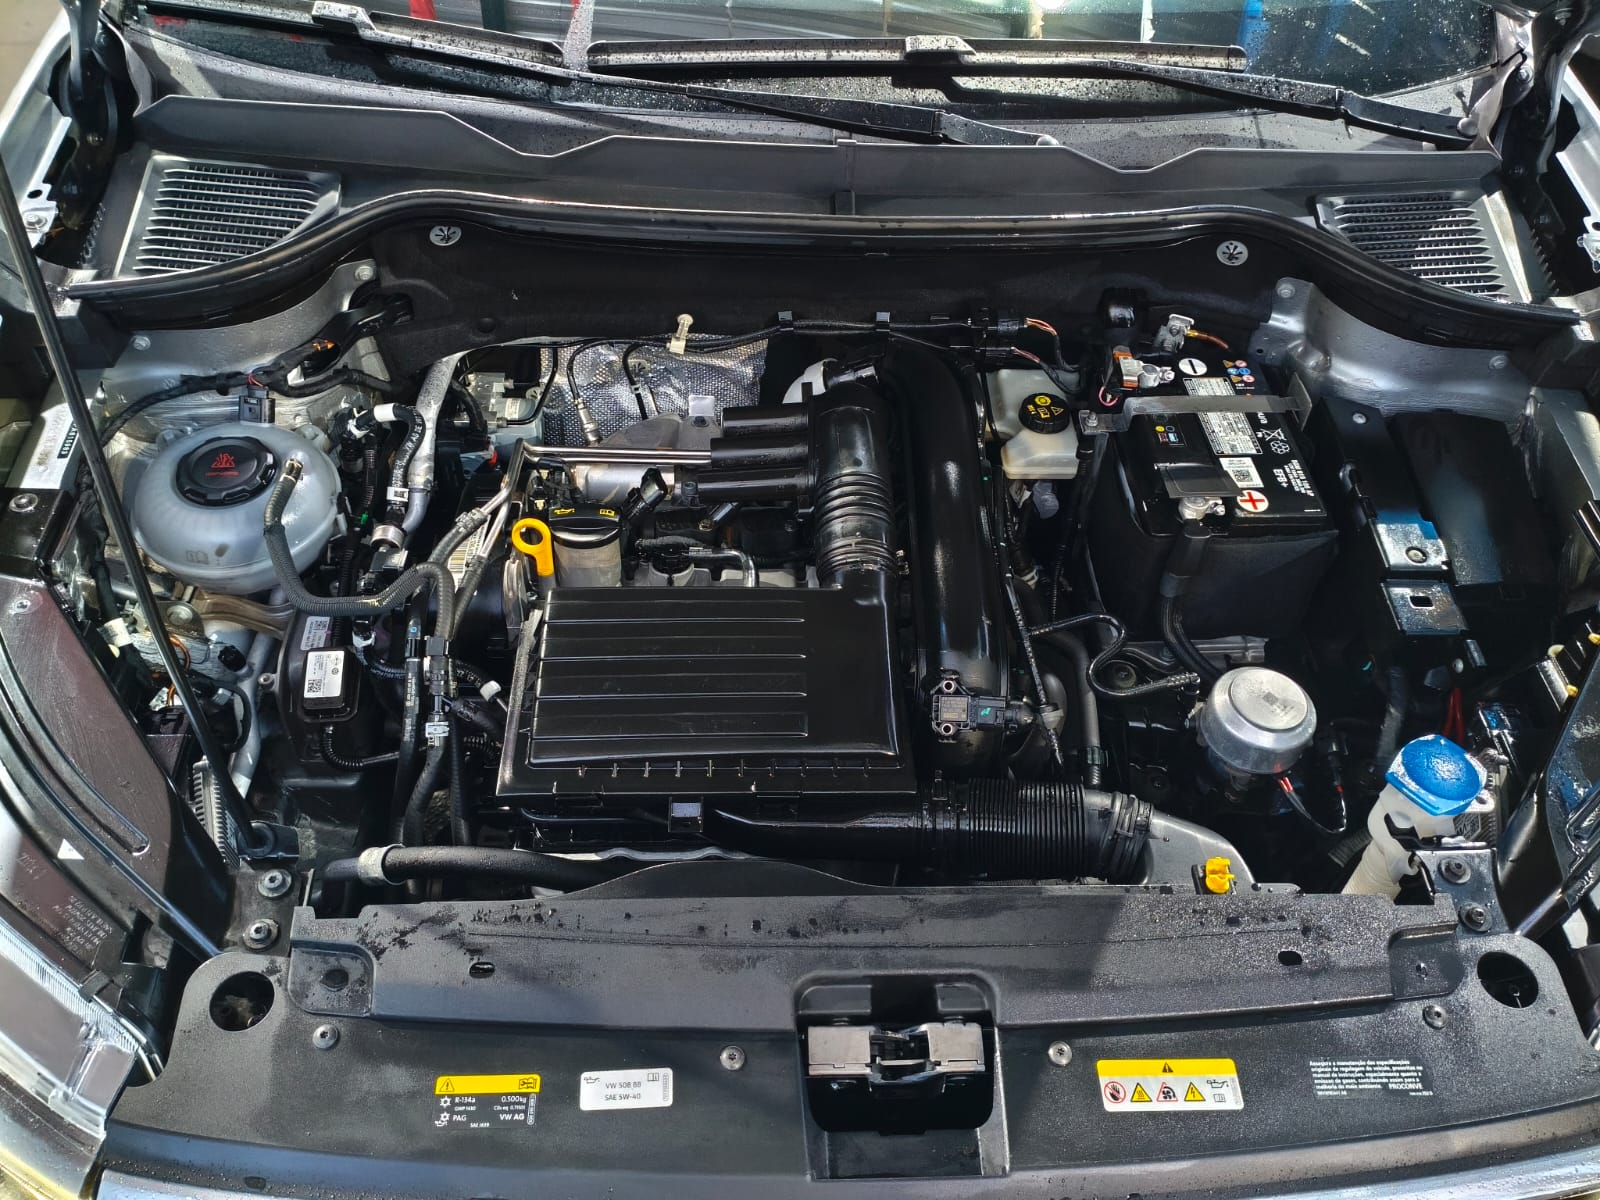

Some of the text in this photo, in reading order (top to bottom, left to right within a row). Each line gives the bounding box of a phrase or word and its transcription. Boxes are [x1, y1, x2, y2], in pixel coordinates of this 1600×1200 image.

[1273, 468, 1288, 488] EFB+
[500, 1113, 512, 1121] VW
[513, 1113, 525, 1121] AG
